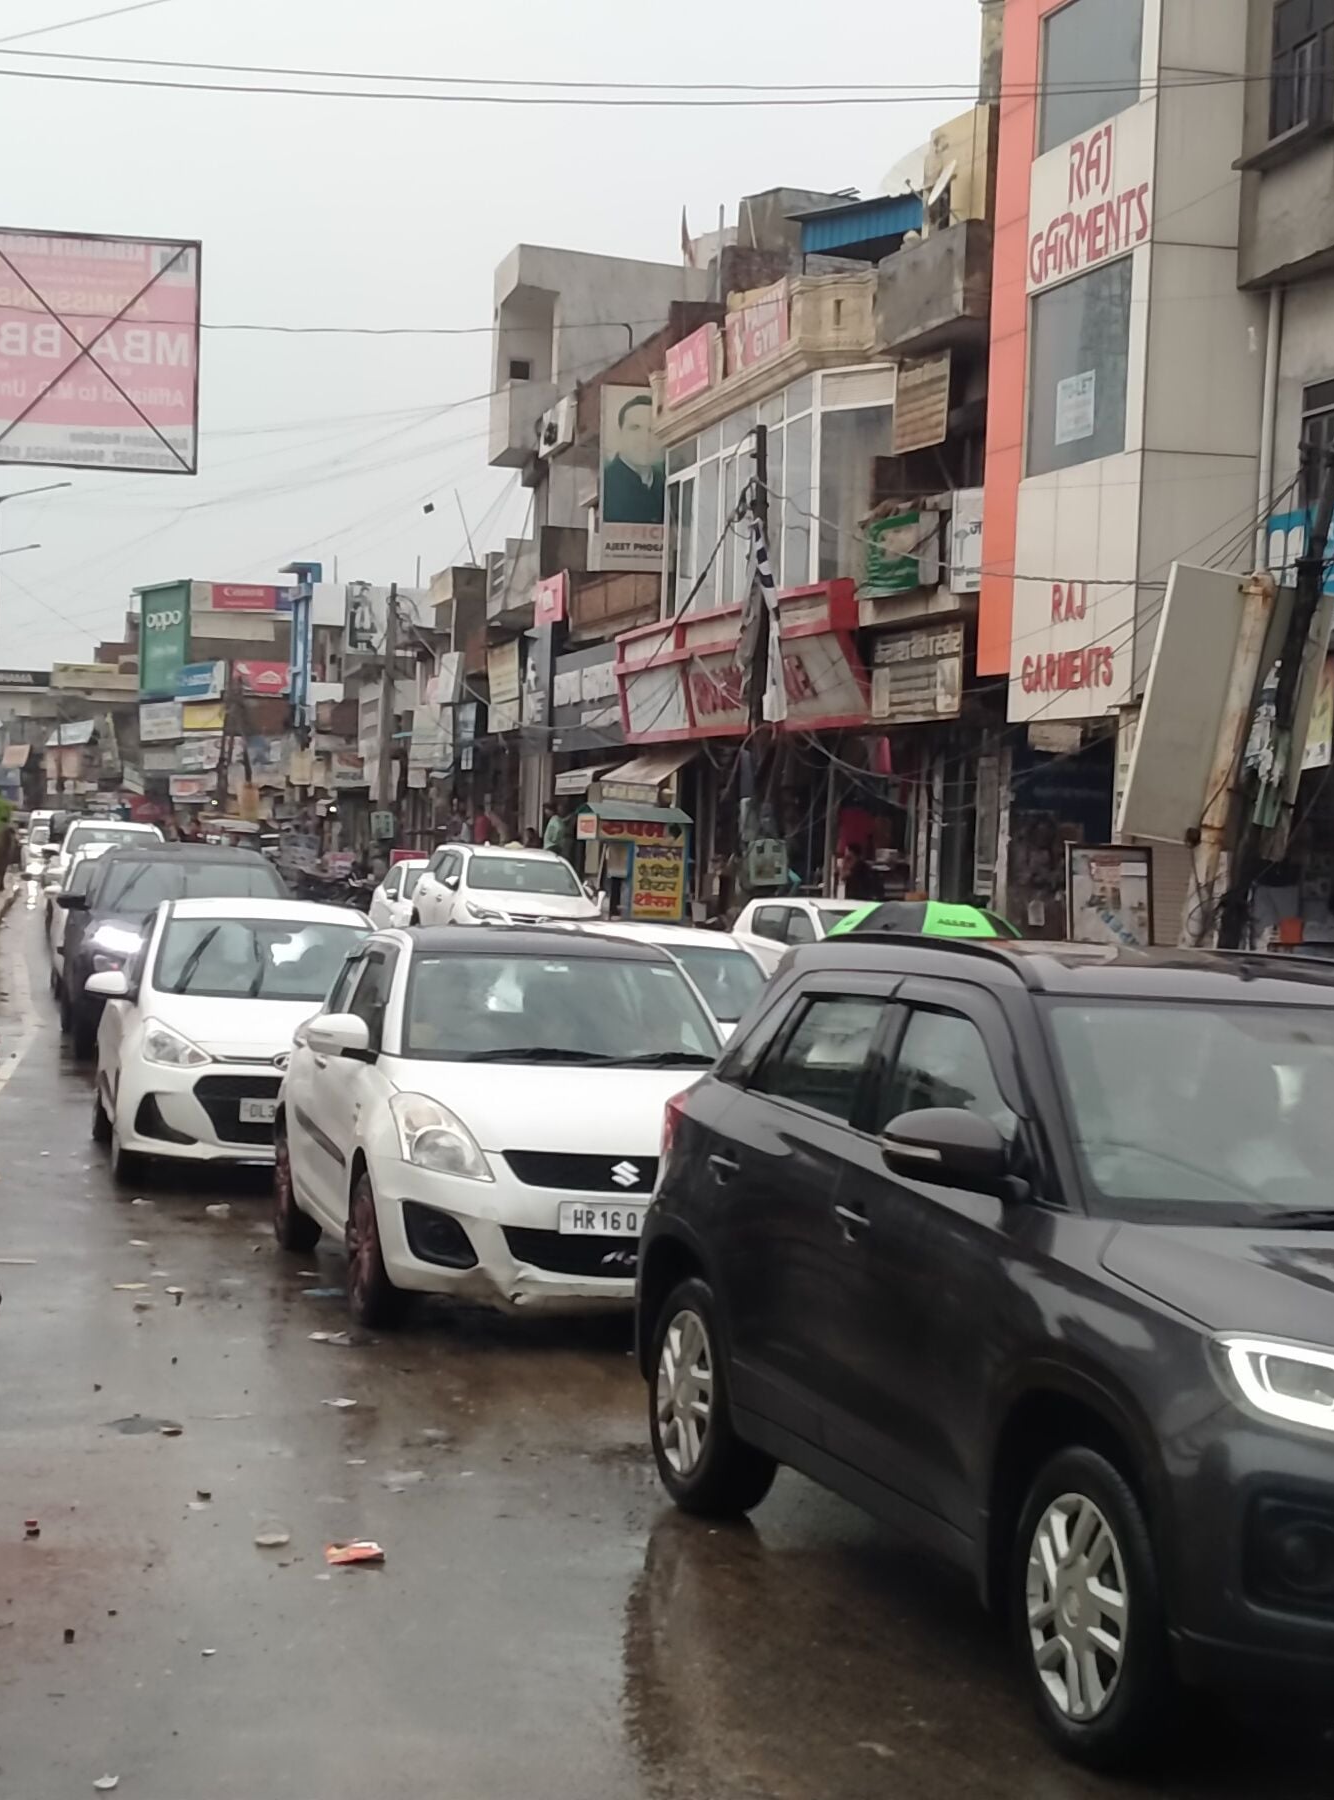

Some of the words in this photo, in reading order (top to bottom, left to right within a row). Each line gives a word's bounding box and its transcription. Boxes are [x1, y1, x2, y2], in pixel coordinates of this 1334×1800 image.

[1069, 124, 1112, 204] RAJ
[1030, 182, 1149, 285] GARMENTS
[1051, 581, 1088, 624] RAJ
[1021, 645, 1115, 695] GARMENTS
